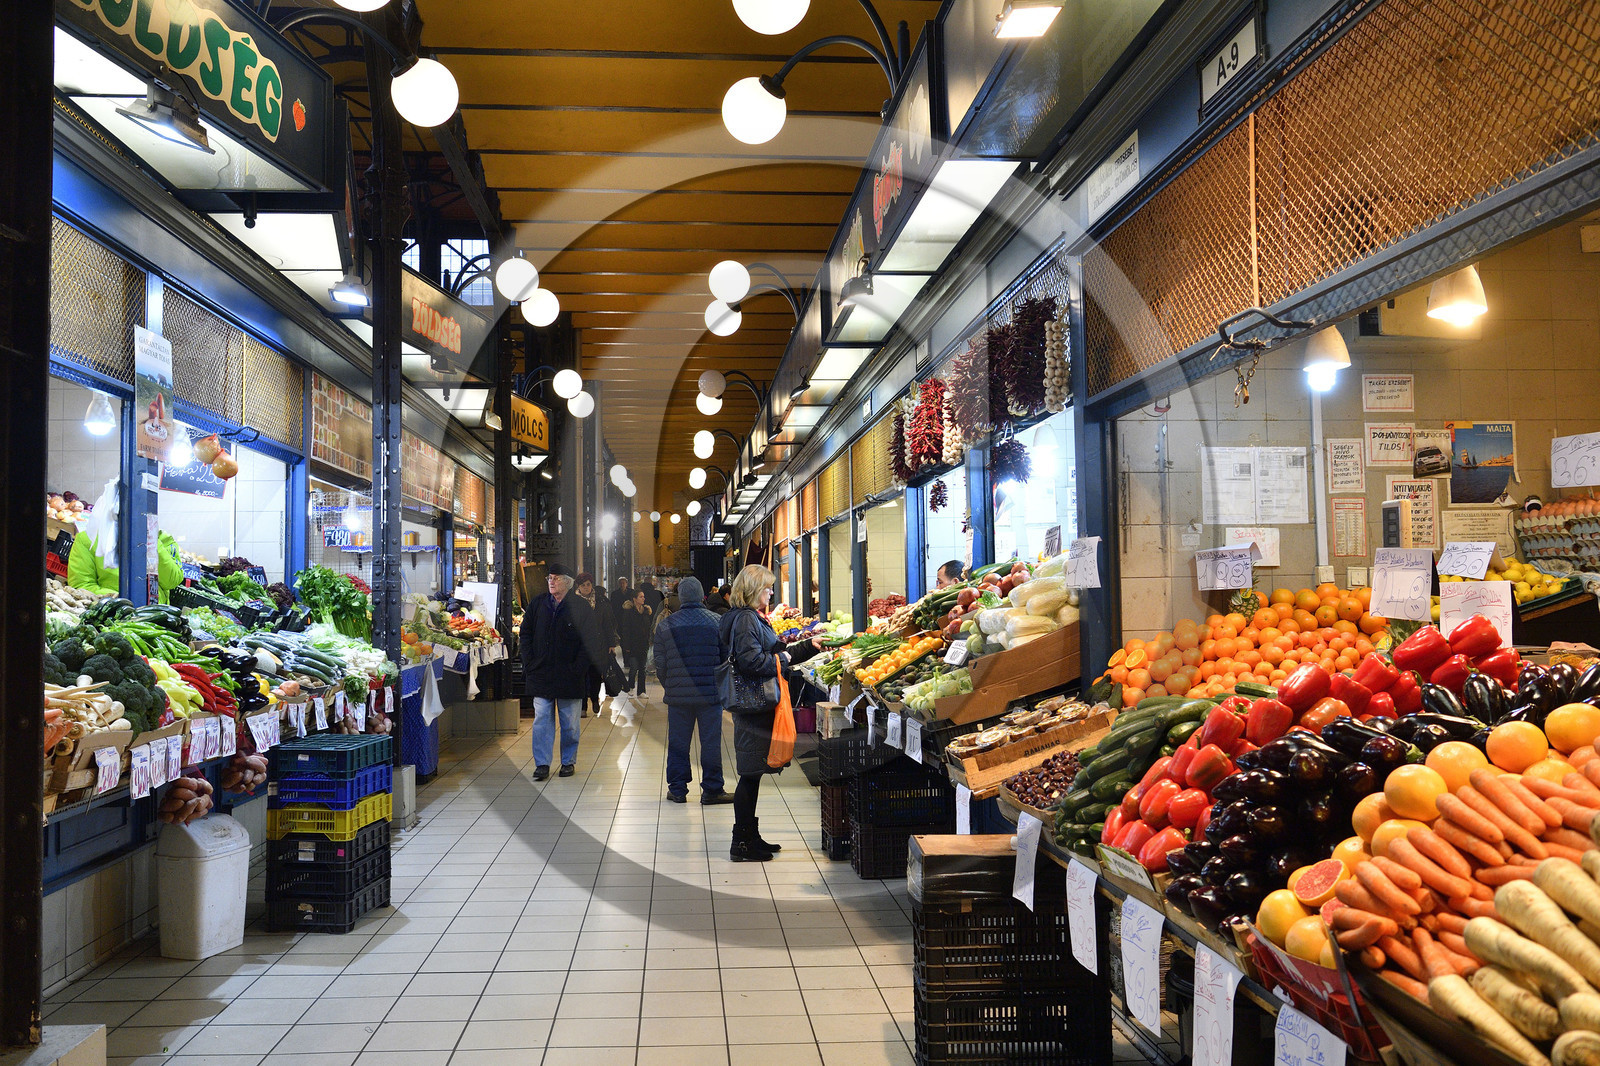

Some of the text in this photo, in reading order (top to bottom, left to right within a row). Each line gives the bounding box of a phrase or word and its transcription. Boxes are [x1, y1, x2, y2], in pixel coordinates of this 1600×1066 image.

[1216, 41, 1239, 87] A-9
[411, 296, 461, 354] ZÖLDSÉG
[1486, 425, 1511, 433] MALTA
